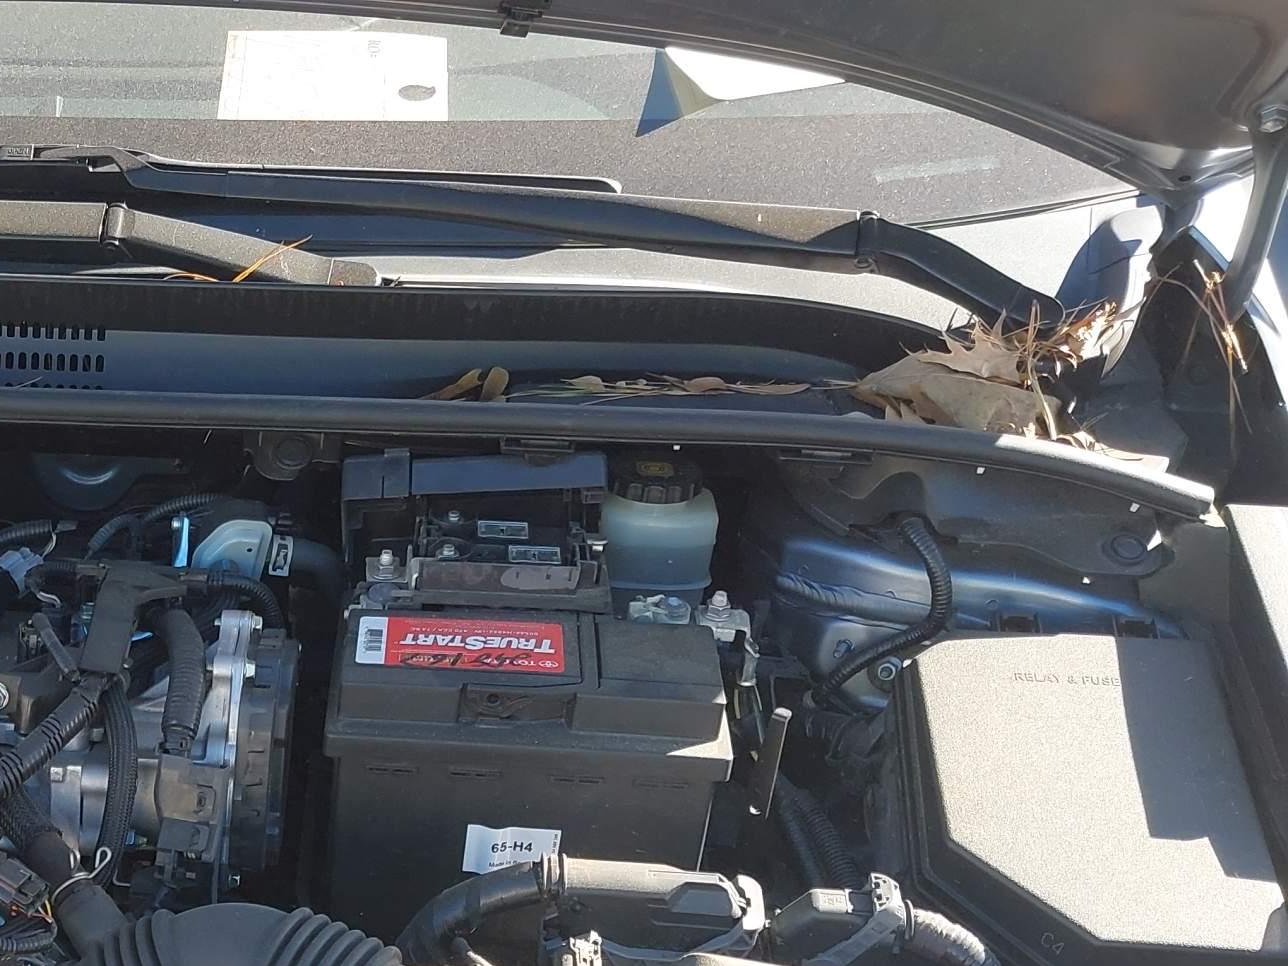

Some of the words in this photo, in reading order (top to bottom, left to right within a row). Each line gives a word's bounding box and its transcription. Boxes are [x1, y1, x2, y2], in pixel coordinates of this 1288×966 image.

[1013, 672, 1060, 684] RELAY
[1067, 675, 1079, 684] &
[1081, 676, 1121, 687] FUSE
[491, 841, 533, 854] 65-H4
